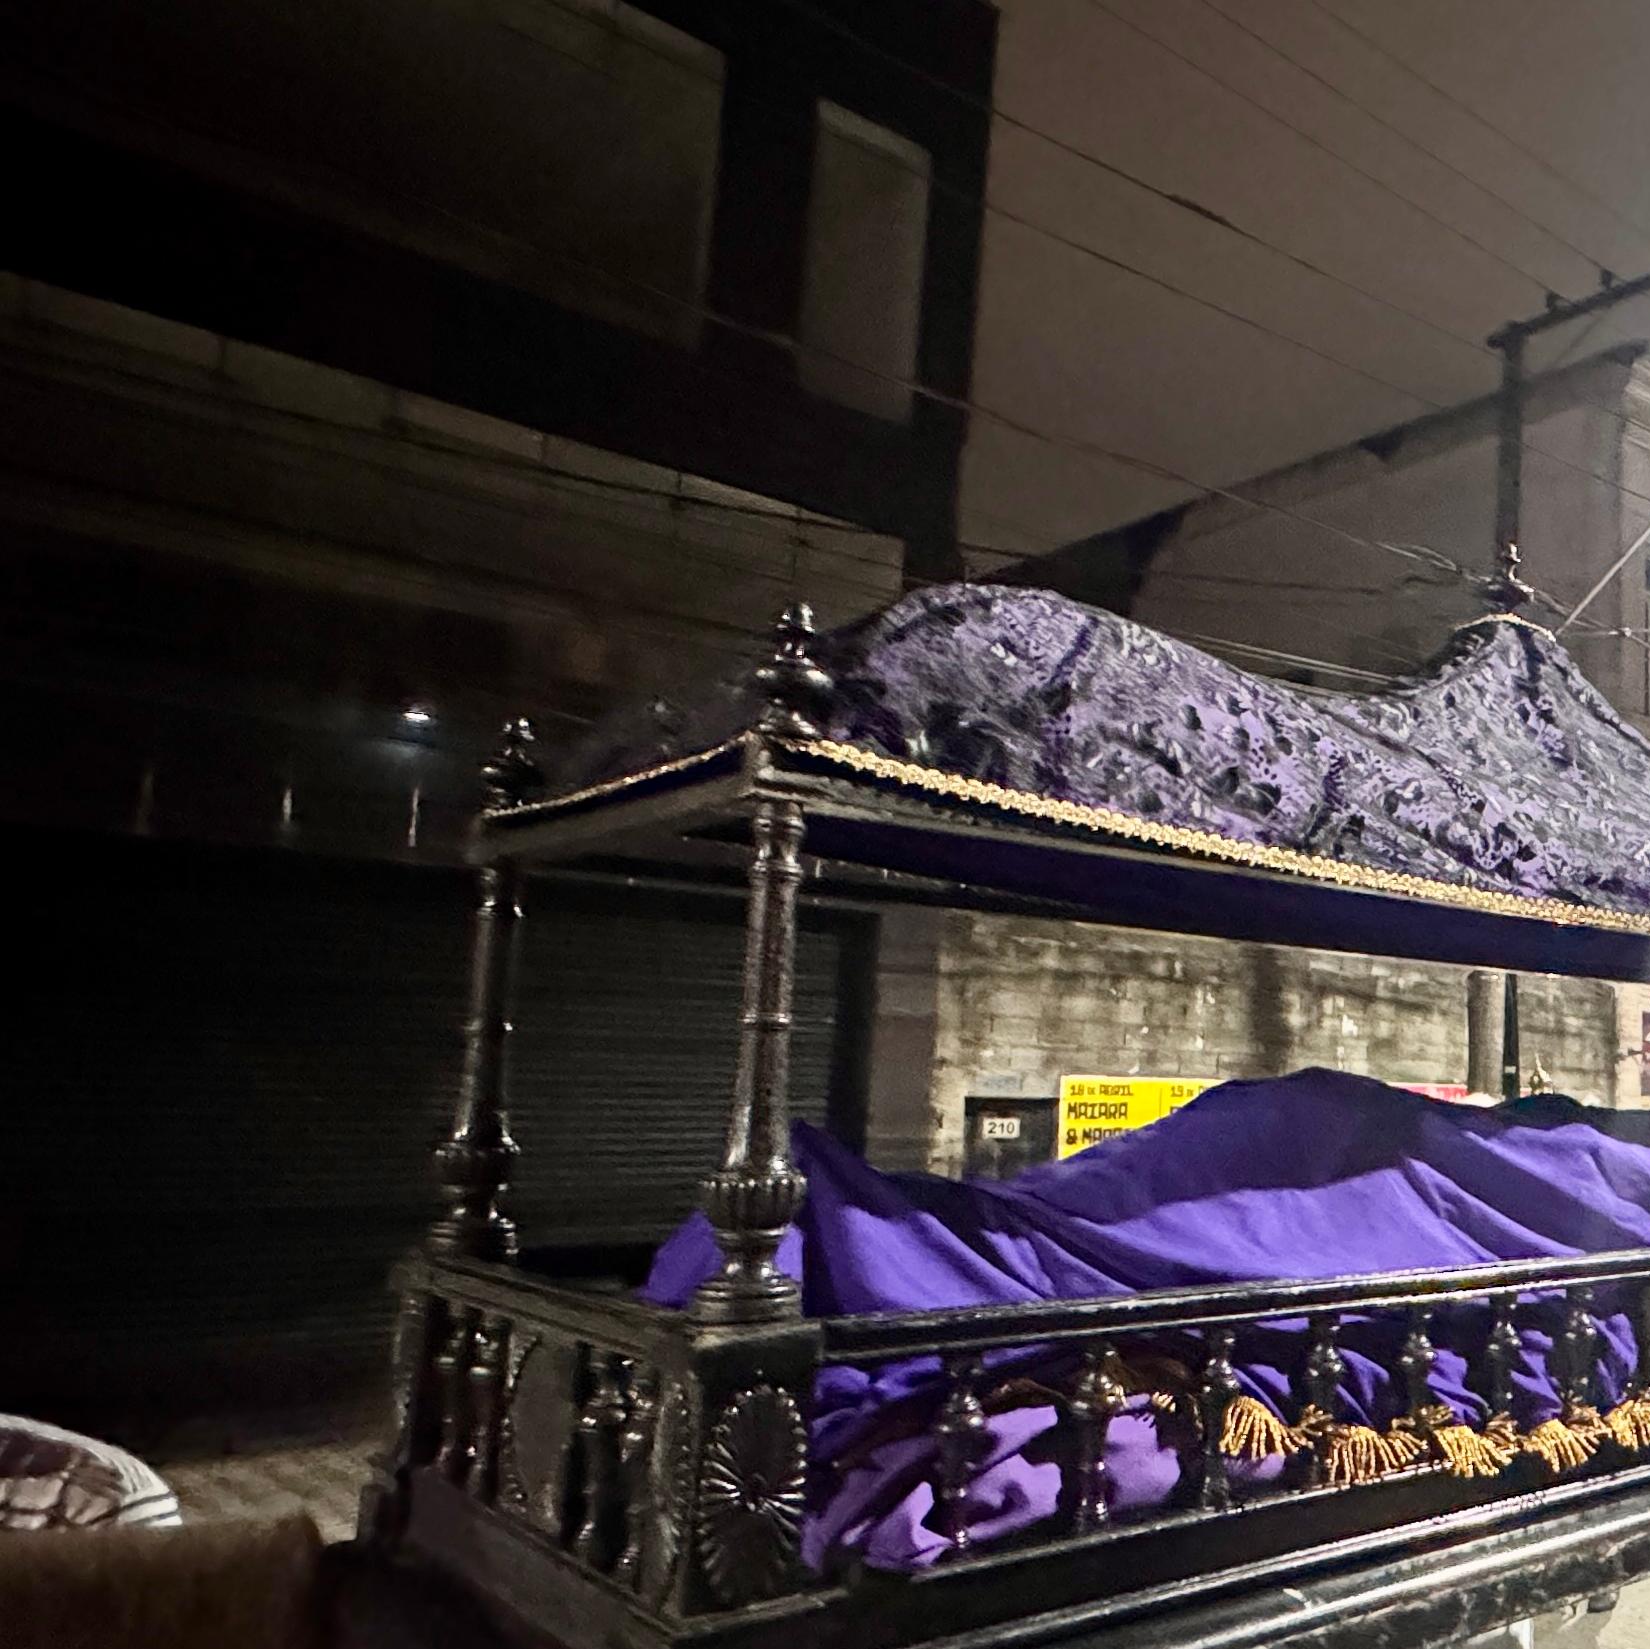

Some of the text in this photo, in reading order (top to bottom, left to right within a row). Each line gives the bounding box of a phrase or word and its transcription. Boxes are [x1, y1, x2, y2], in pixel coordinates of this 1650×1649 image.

[1099, 1084, 1134, 1096] ABRIL
[1067, 1102, 1128, 1119] MAIARA
[988, 1122, 1015, 1134] 210
[1066, 1127, 1078, 1145] &
